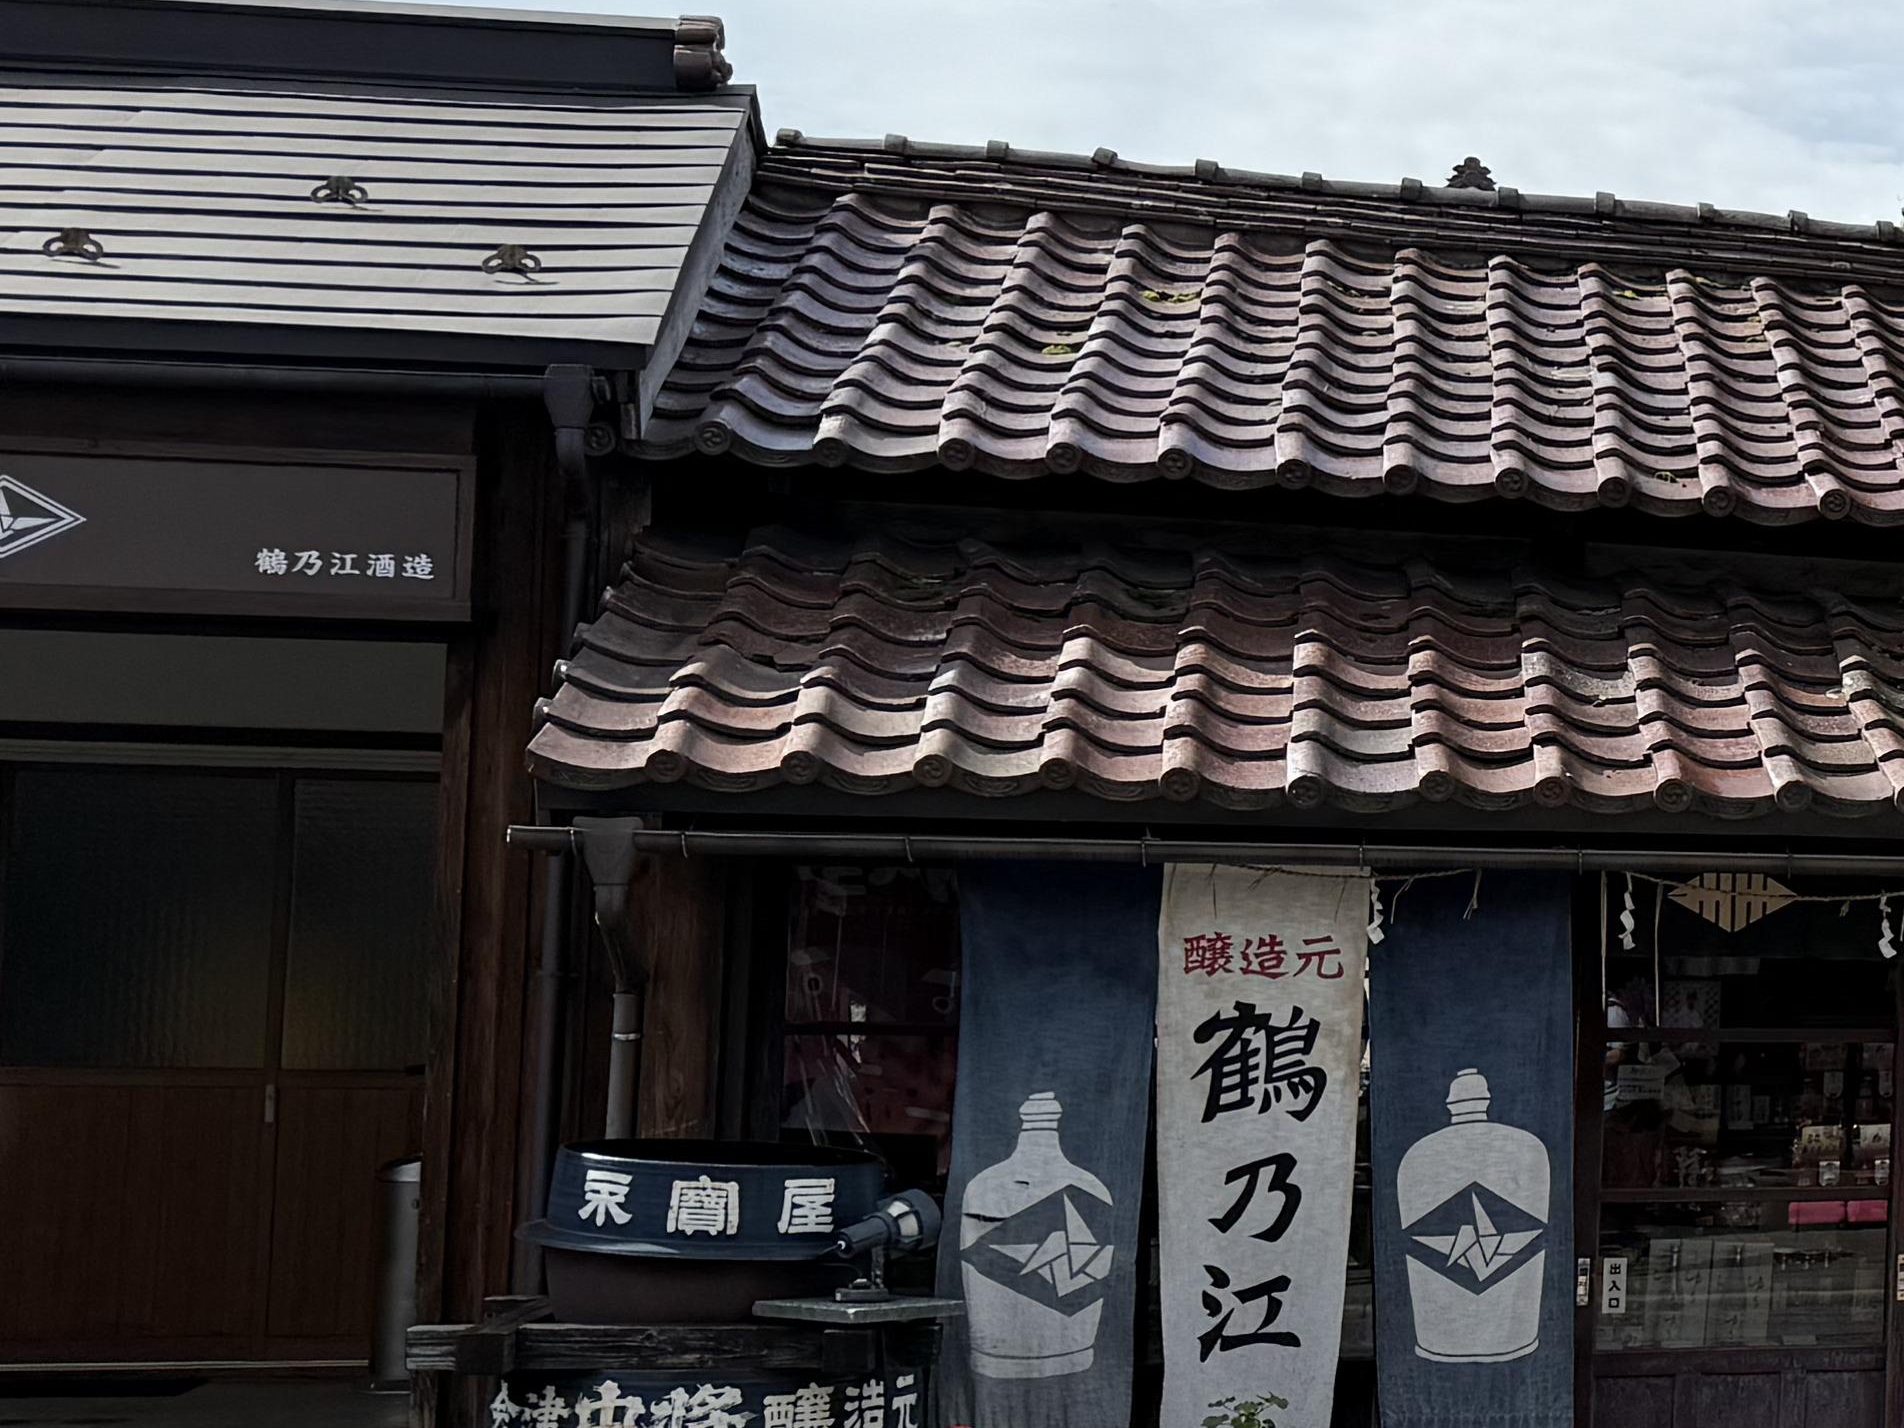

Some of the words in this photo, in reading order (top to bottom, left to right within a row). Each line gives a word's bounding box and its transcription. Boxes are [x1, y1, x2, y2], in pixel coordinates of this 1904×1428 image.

[254, 547, 435, 580] 鶴乃江酒造
[1183, 931, 1344, 980] 醸造元
[1189, 1000, 1328, 1363] 鶴乃江
[1608, 1263, 1622, 1309] 出入口
